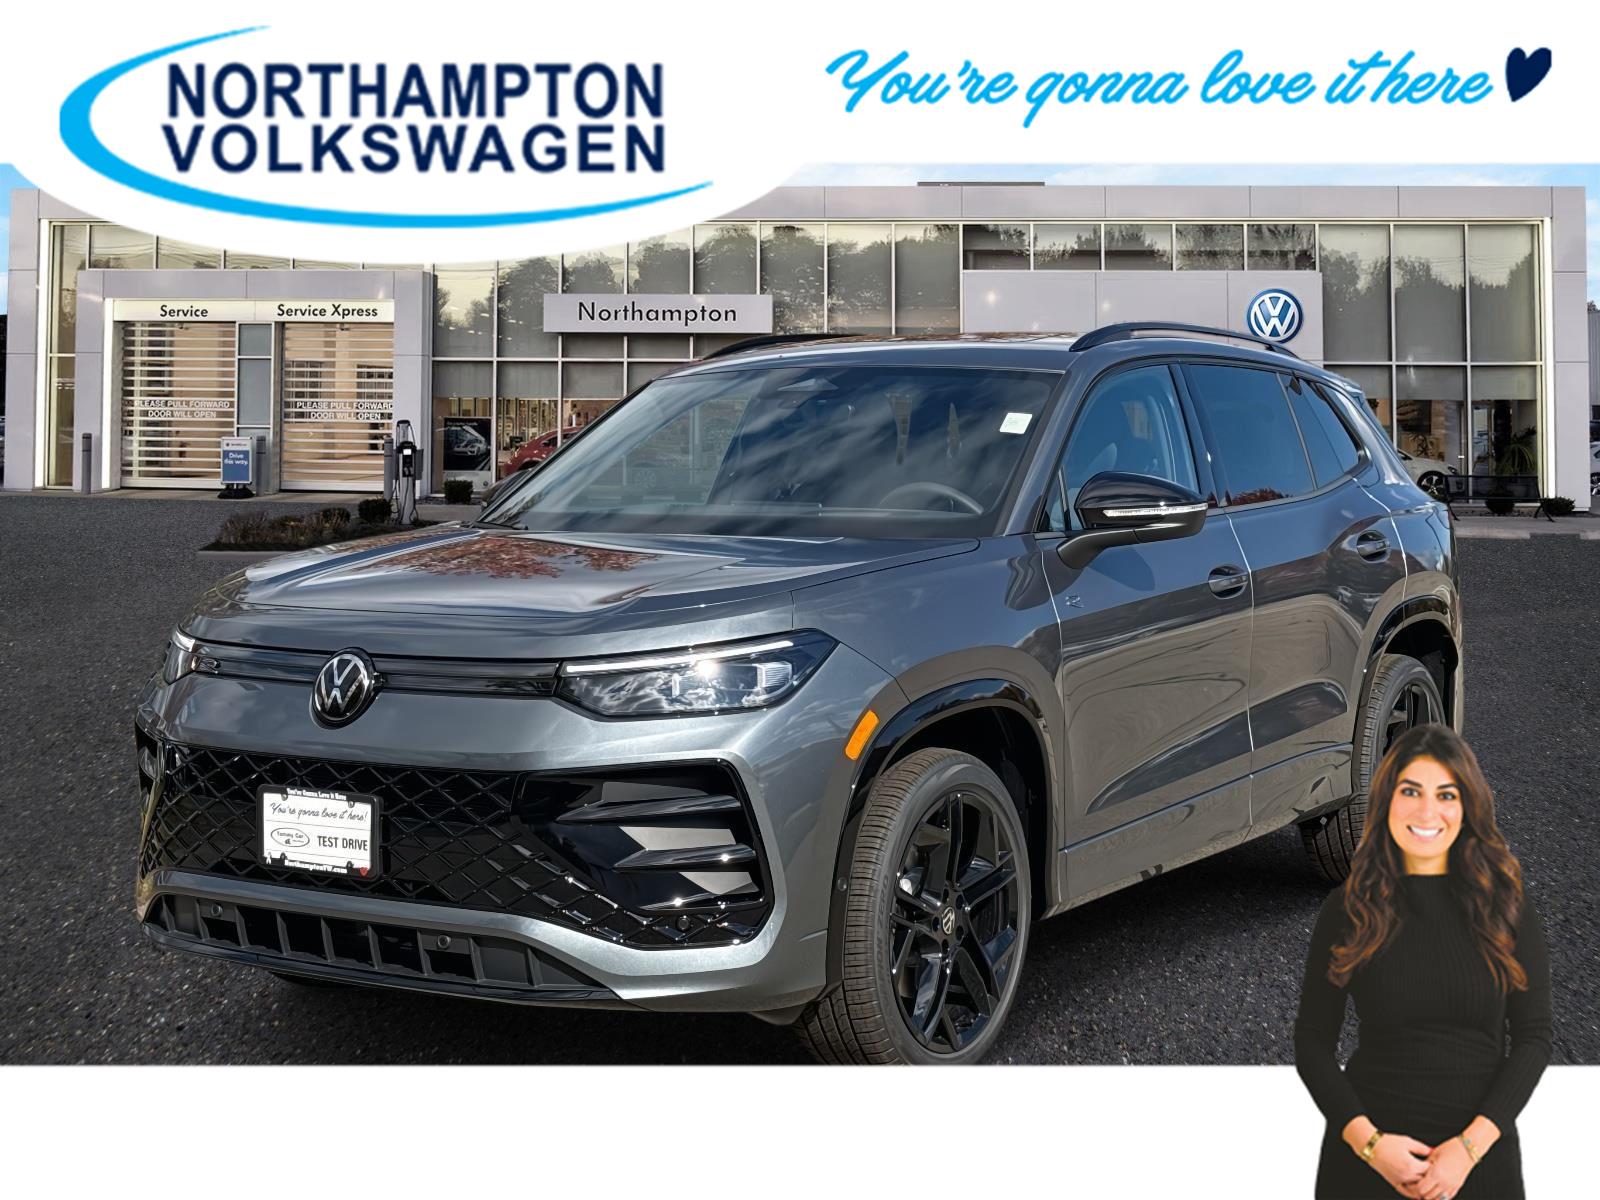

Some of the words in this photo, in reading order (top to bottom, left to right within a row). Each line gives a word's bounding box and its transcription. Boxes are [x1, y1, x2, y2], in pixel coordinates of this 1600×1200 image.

[160, 305, 209, 318] Service
[277, 304, 327, 317] Service
[331, 304, 378, 320] Xpress
[578, 301, 737, 327] Northampton
[135, 400, 165, 408] PLEASE
[167, 400, 188, 408] PULL
[189, 400, 230, 408] FORWARD
[296, 401, 328, 409] PLEASE
[330, 401, 352, 409] PULL
[353, 401, 394, 410] FORWARD
[148, 410, 171, 418] DOOR
[310, 412, 334, 420] DOOR
[337, 412, 356, 420] WILL
[357, 412, 381, 420] OPEN
[298, 808, 320, 820] gonna
[321, 807, 337, 818] love
[339, 810, 348, 819] it
[317, 835, 339, 848] TEST
[342, 838, 368, 851] DRIVE
